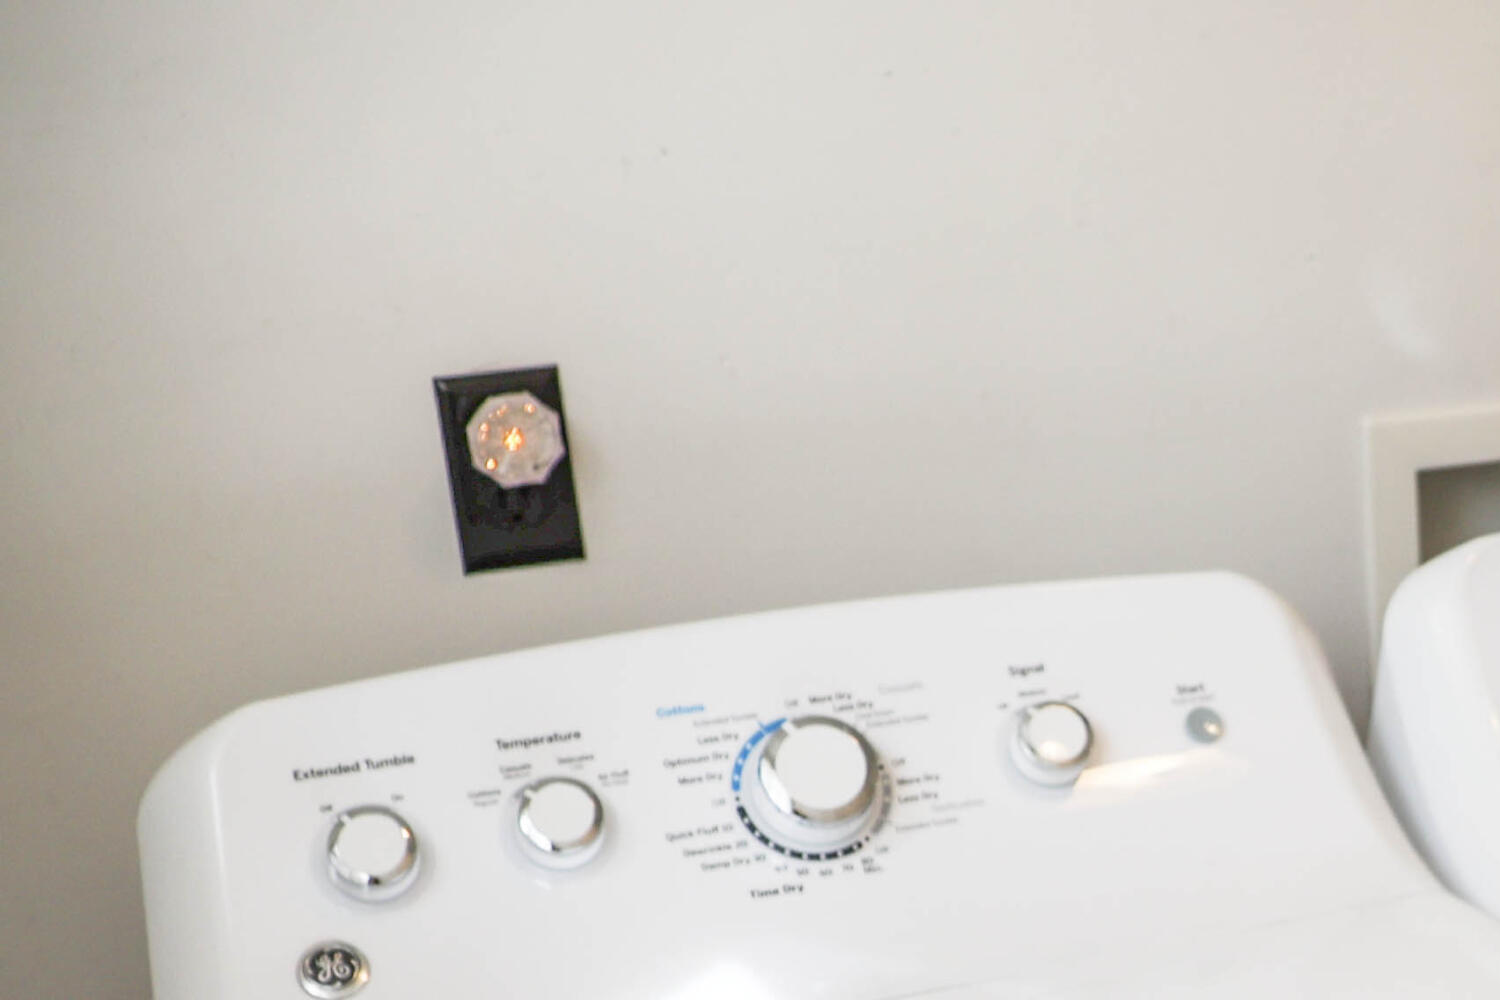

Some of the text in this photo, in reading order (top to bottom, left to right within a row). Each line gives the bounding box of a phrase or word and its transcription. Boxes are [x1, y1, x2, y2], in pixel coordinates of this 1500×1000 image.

[1008, 662, 1045, 677] Signal
[655, 703, 705, 719] Cottons
[495, 729, 582, 751] Temperature
[292, 753, 415, 782] Extended Tumble
[750, 881, 805, 900] Time Dry
